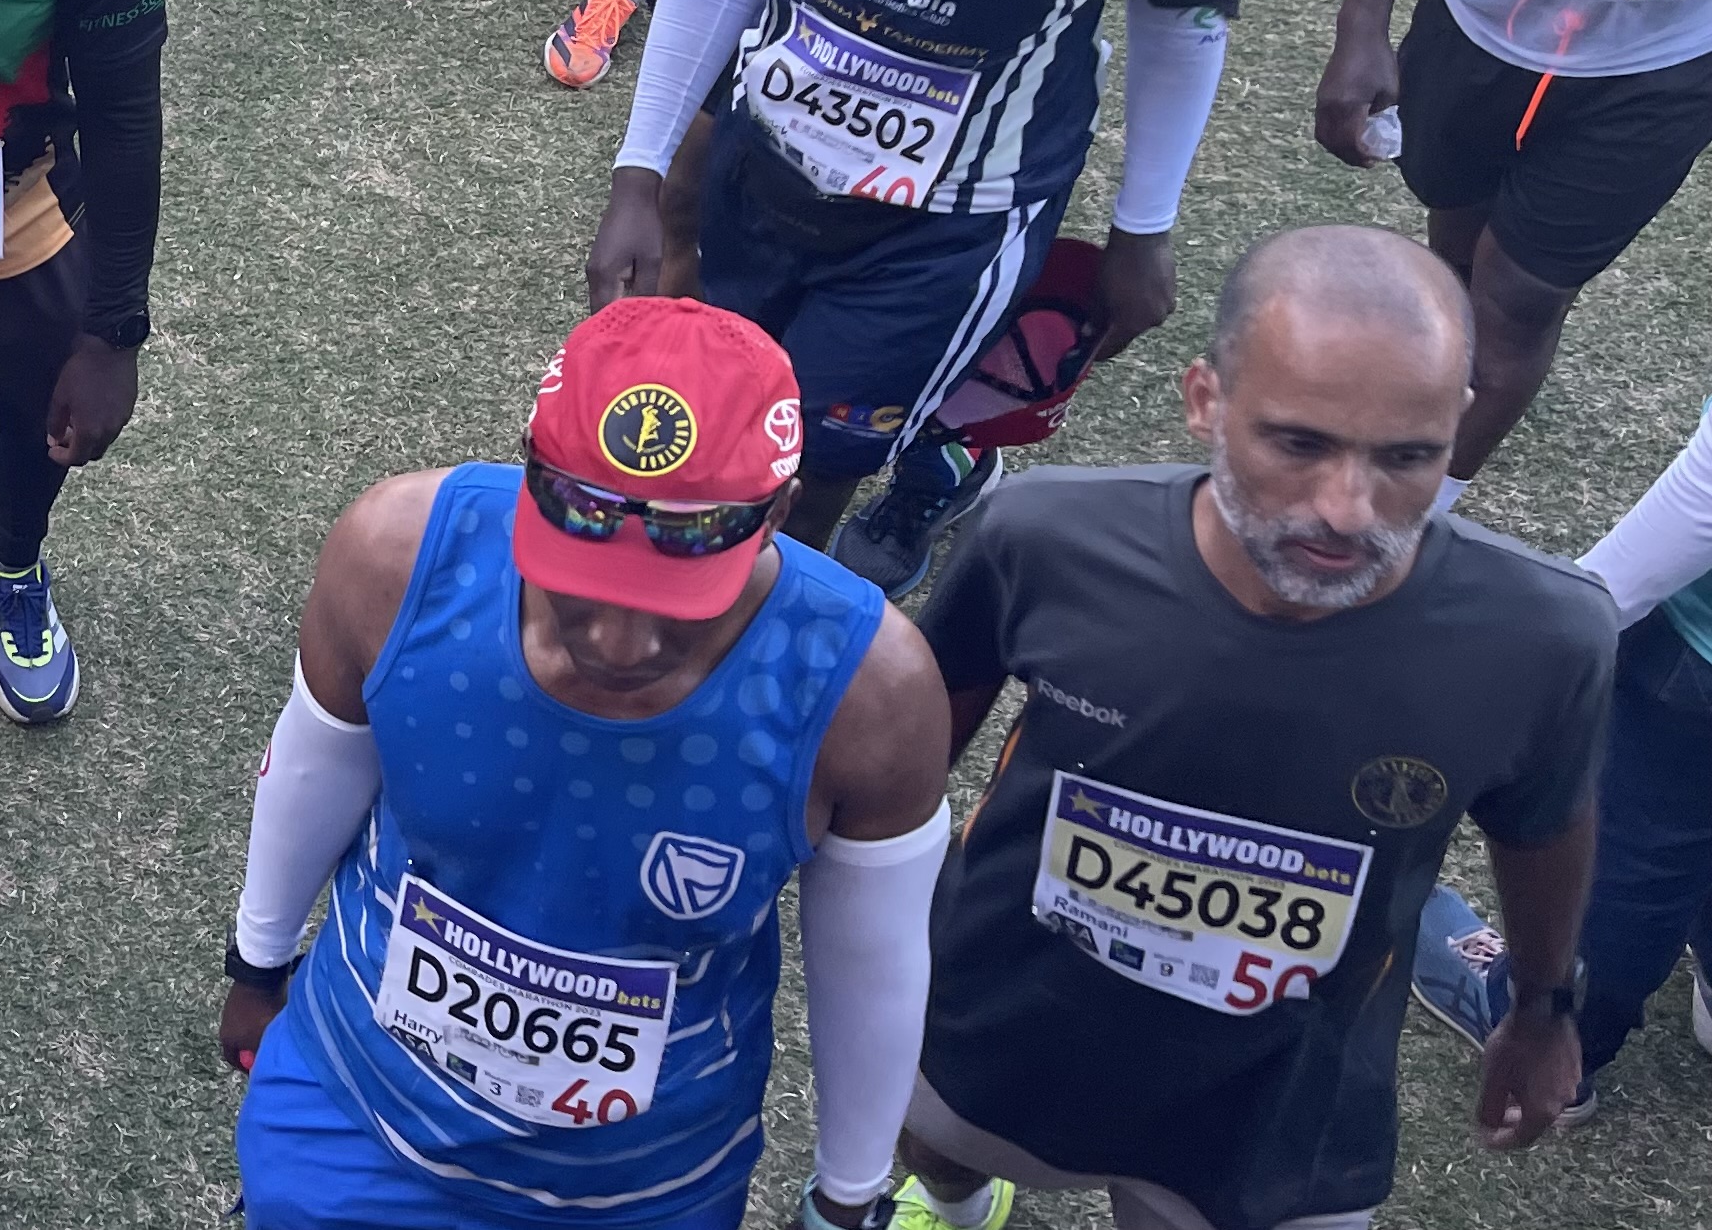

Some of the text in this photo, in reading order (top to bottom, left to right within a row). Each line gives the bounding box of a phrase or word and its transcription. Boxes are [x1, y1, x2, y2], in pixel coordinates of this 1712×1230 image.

[883, 26, 989, 59] TAXIDERMY
[760, 57, 935, 164] D43502
[848, 165, 916, 209] 40
[1037, 678, 1128, 730] Reebok
[1053, 895, 1130, 939] Ramani
[1065, 834, 1326, 951] D45038
[448, 954, 602, 1018] COMRADES MARATHON 2023
[1224, 950, 1319, 1010] 50
[393, 1008, 444, 1045] Harry
[406, 944, 640, 1074] D20665
[489, 1081, 502, 1096] 3
[550, 1077, 639, 1126] 40
